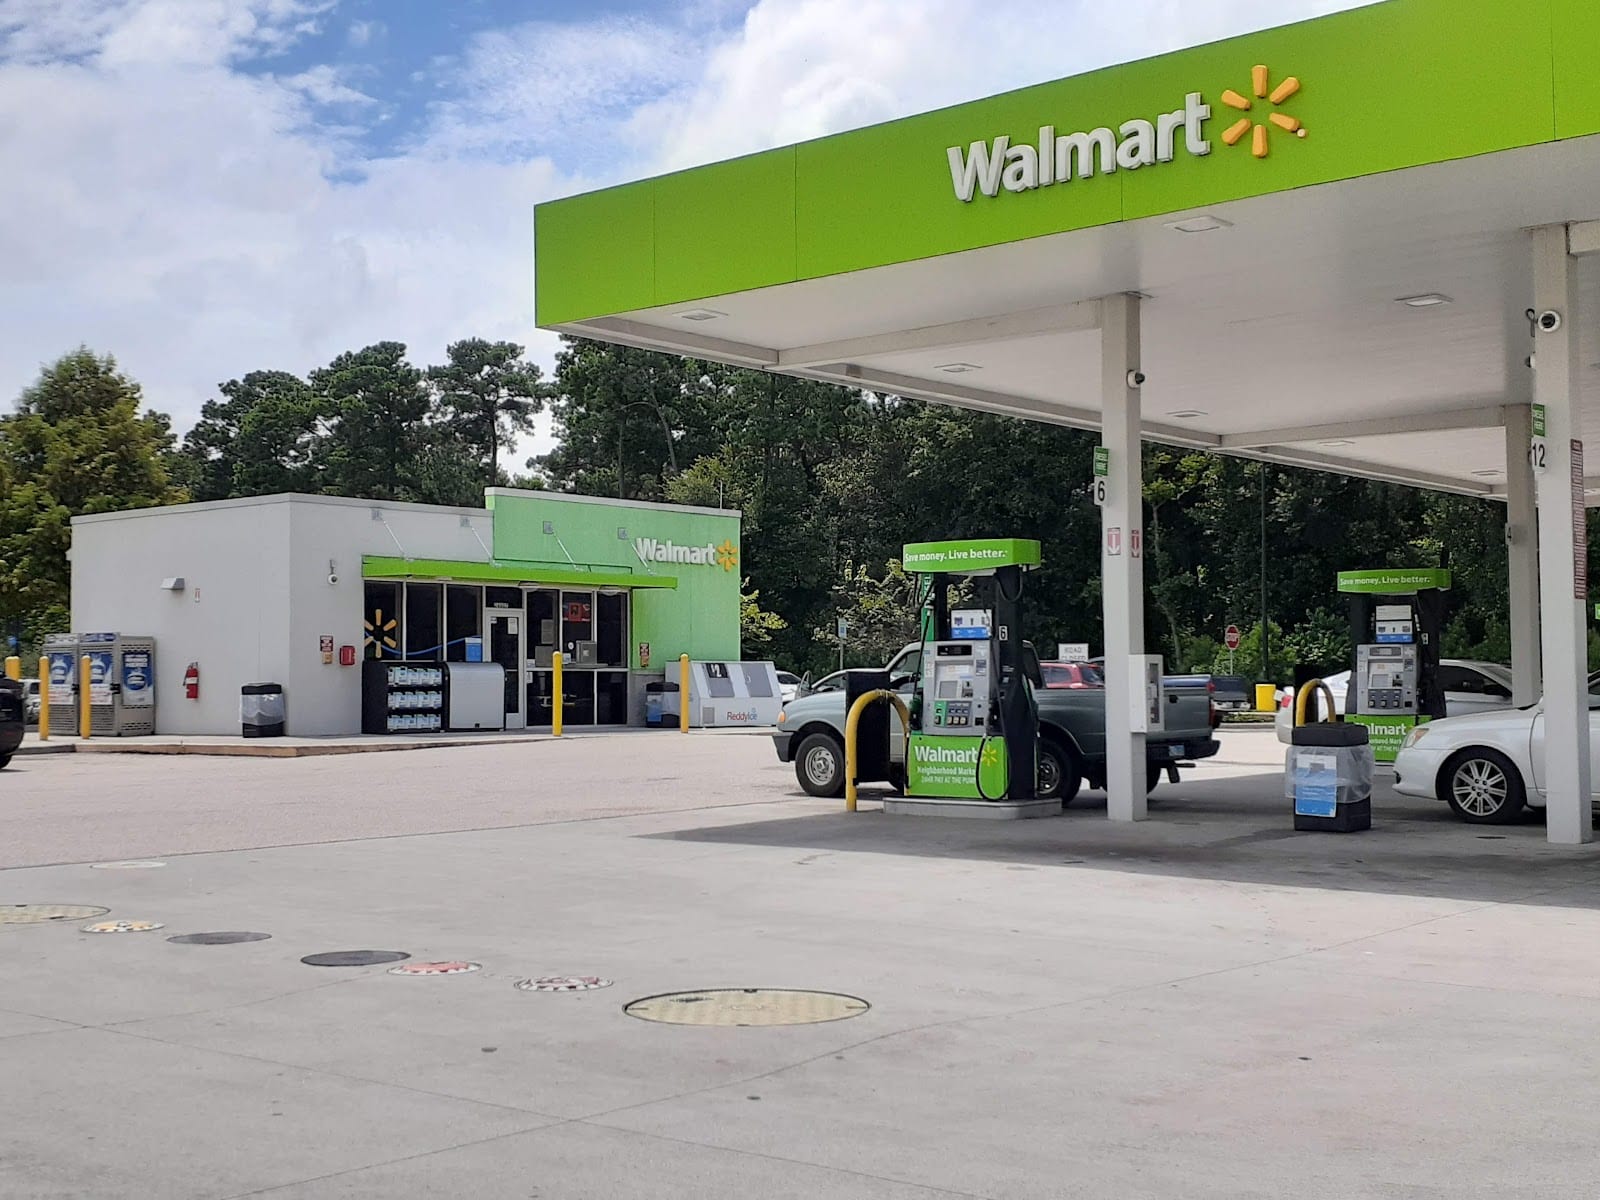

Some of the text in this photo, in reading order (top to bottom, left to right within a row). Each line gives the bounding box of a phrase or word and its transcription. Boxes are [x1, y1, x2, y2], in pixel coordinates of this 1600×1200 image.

[946, 92, 1211, 202] Walmart
[1532, 443, 1545, 467] 12
[1098, 480, 1105, 501] 6
[636, 538, 716, 566] Walmart
[919, 552, 947, 562] money.
[948, 549, 968, 560] Live
[970, 548, 1005, 559] better.
[1382, 575, 1400, 584] Live
[1000, 626, 1006, 640] 6
[1356, 722, 1407, 735] lmart
[914, 745, 979, 763] Walmart
